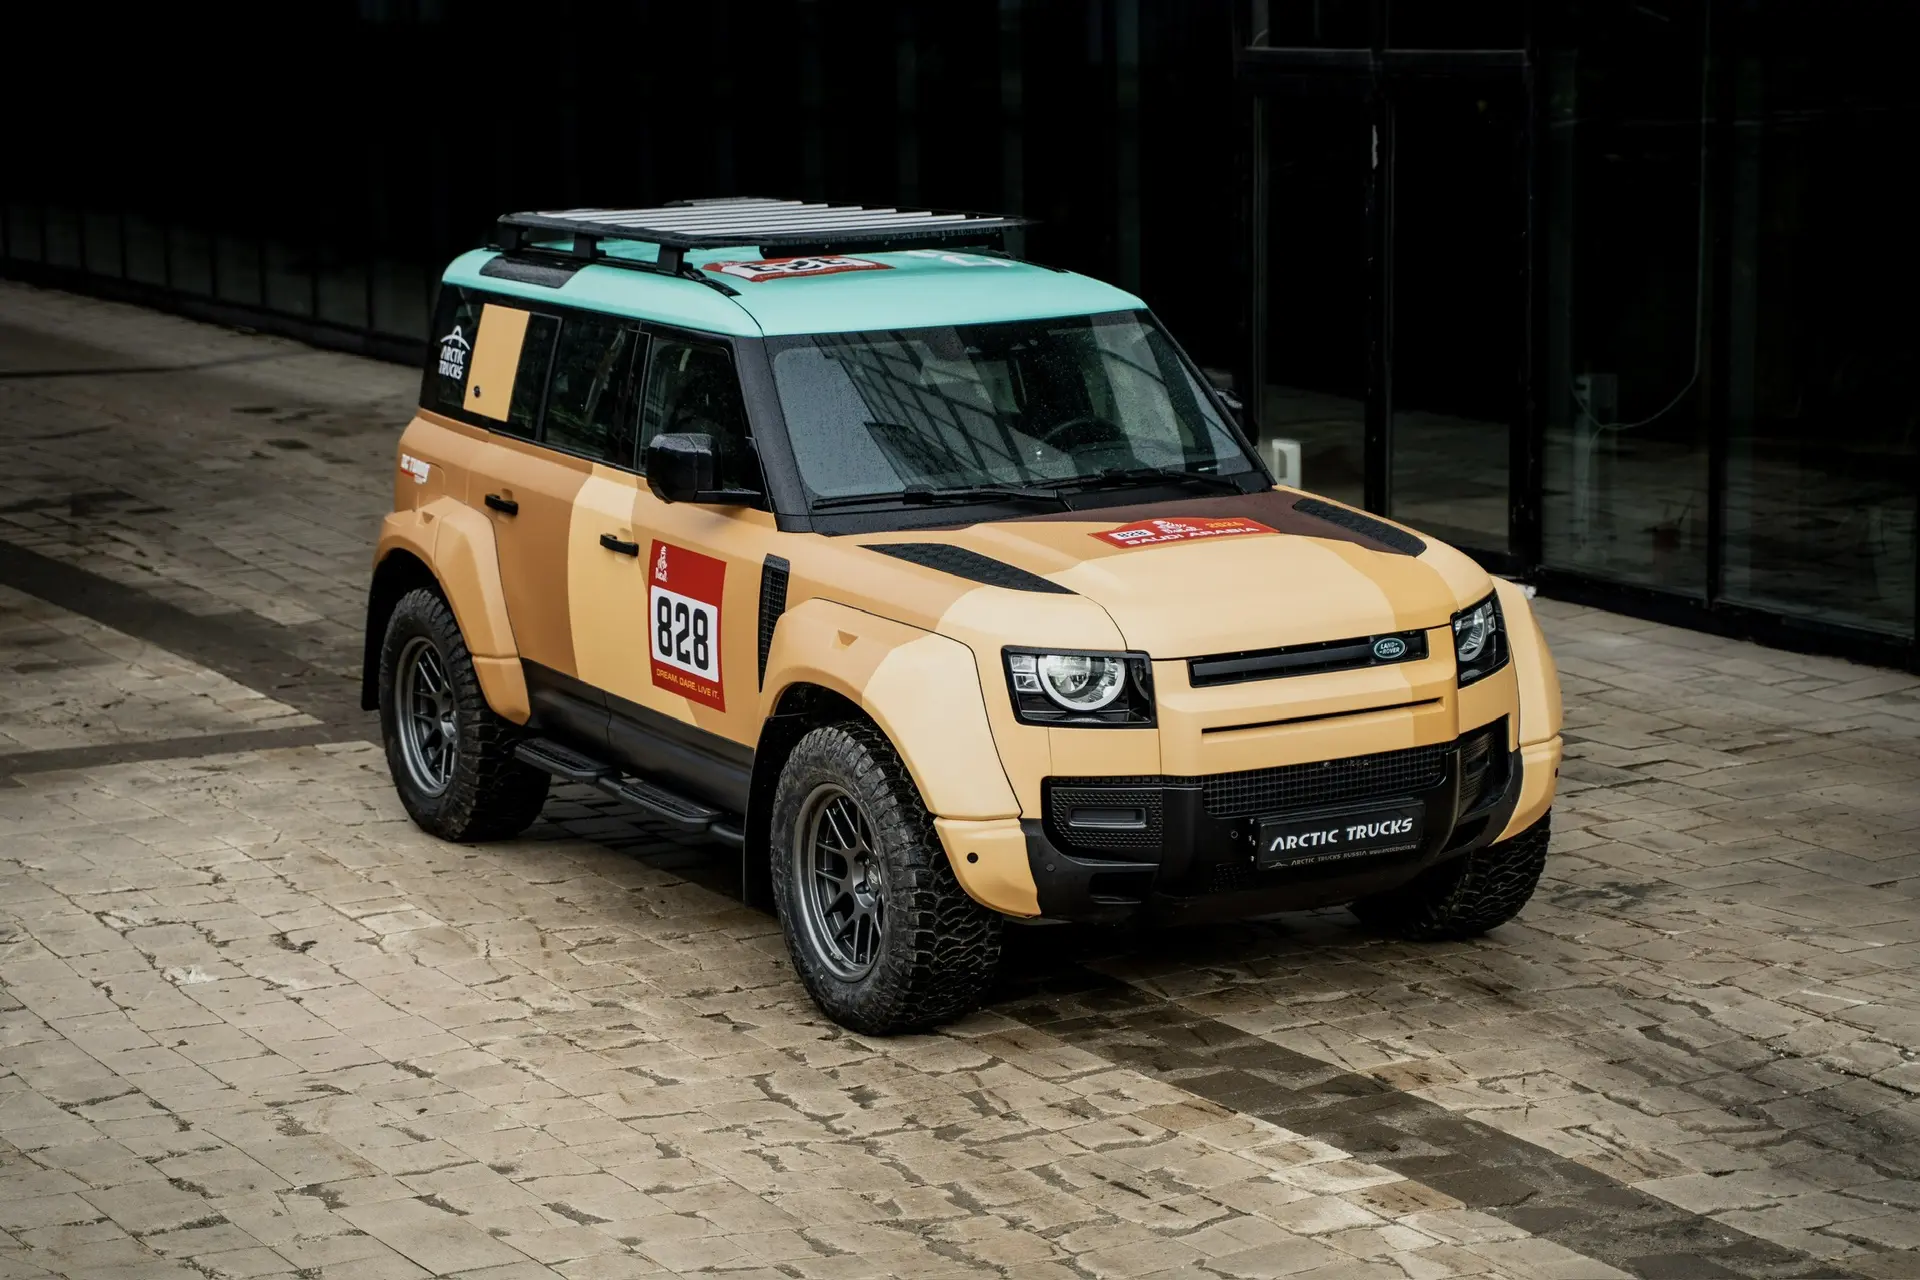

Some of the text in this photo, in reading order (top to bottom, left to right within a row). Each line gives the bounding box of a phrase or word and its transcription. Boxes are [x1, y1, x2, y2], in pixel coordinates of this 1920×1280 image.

[440, 345, 465, 365] ARCTIC
[438, 360, 463, 379] TRUCKS
[1116, 530, 1148, 539] 828
[1125, 527, 1260, 544] SAUDI ARABIA
[657, 596, 709, 671] 828
[1382, 646, 1400, 654] ROVER
[656, 668, 678, 684] DREAM.
[679, 677, 697, 691] DARE.
[697, 684, 712, 697] LIVE
[1269, 817, 1413, 852] ARCTIC TRUCKS
[1291, 857, 1315, 866] ARCTIC
[1318, 853, 1342, 862] TRUCKS
[1343, 850, 1367, 860] RUSSIA
